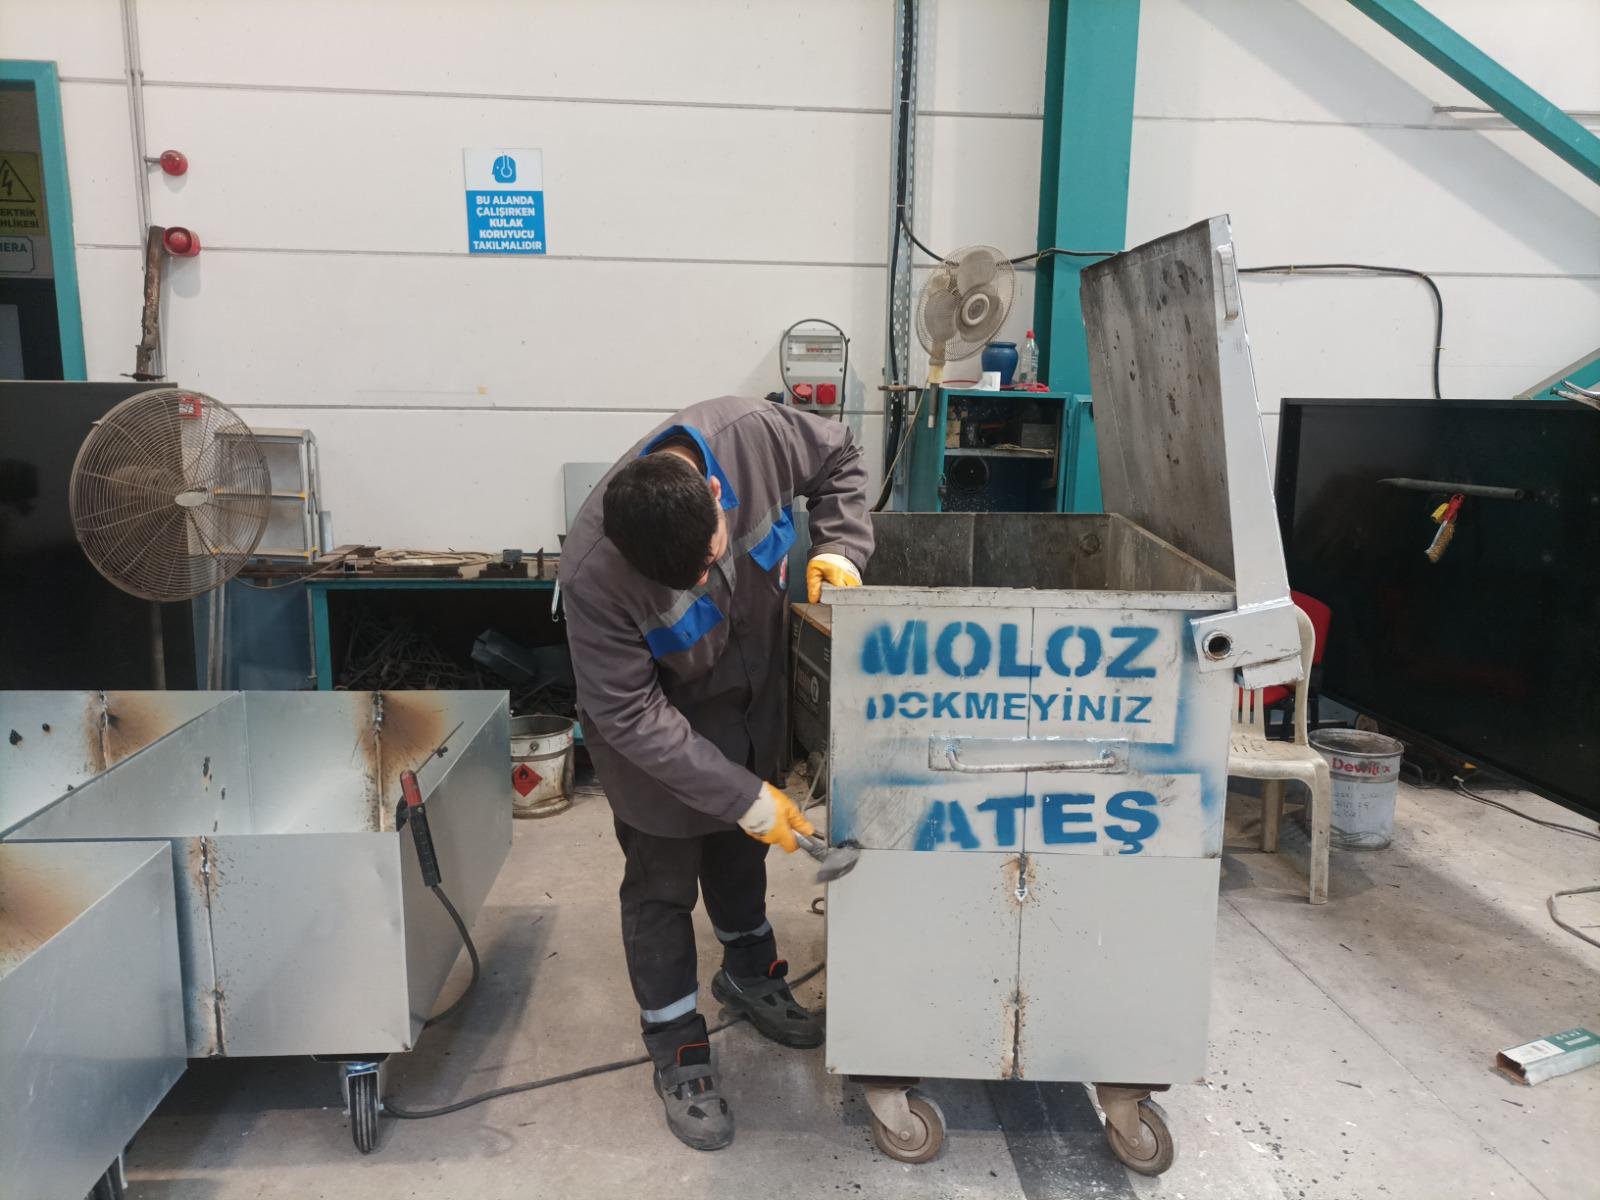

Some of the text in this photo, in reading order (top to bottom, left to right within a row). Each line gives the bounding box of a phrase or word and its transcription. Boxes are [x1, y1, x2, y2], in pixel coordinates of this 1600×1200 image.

[476, 195, 534, 204] BU ALANDA
[476, 207, 535, 217] ÇALIŞIRKEN
[489, 218, 523, 227] KULAK
[479, 229, 535, 239] KORUYUCU
[472, 240, 543, 250] TAKILMALIDIR
[860, 619, 1160, 679] MOLOZ
[912, 789, 1160, 855] ATEŞ
